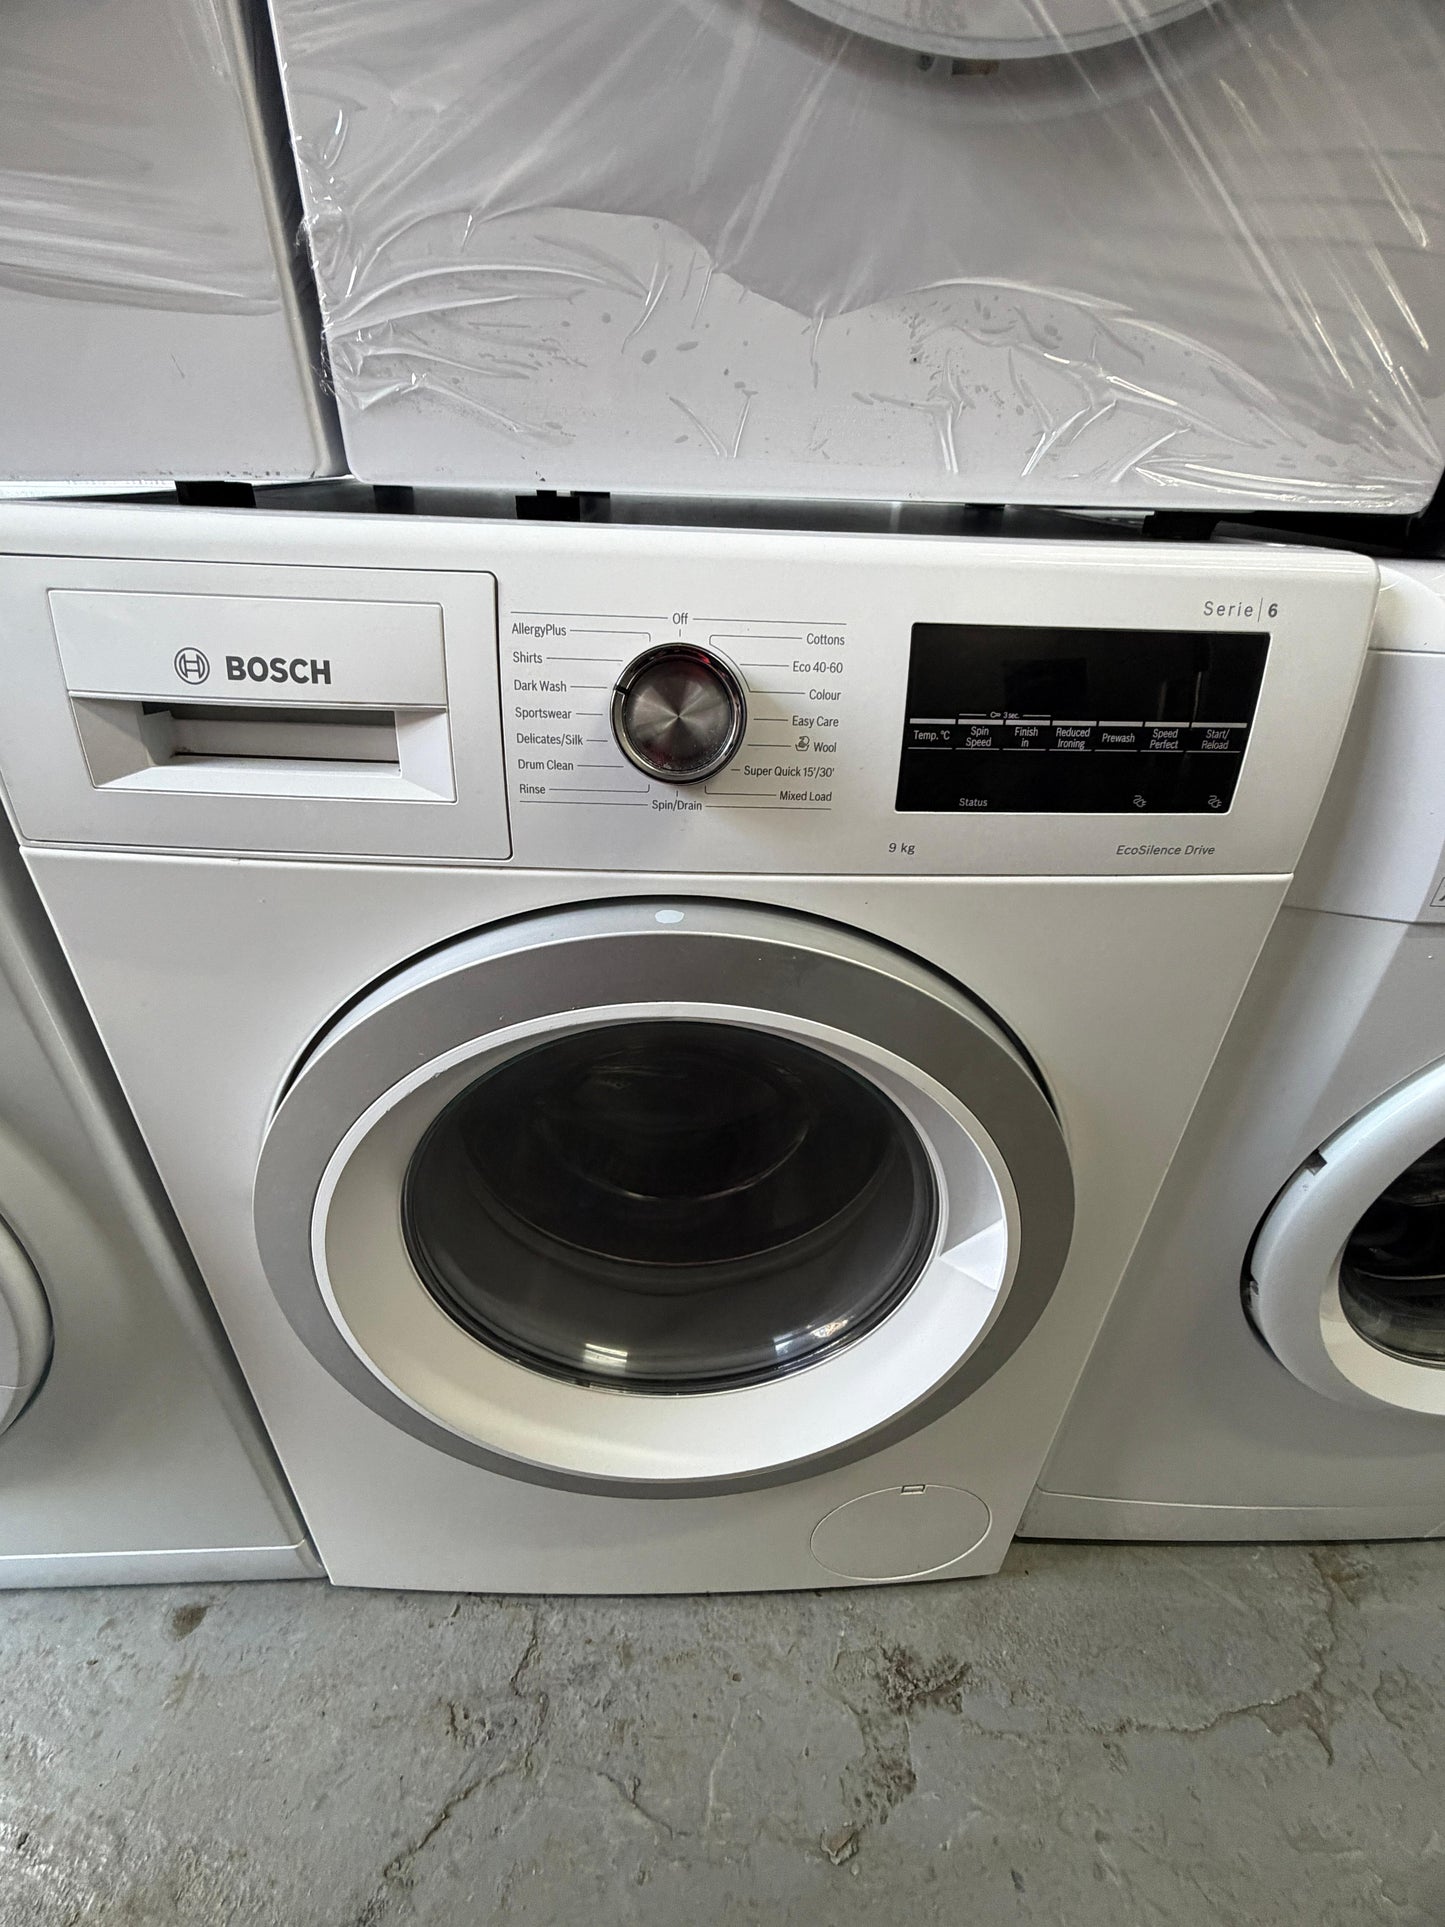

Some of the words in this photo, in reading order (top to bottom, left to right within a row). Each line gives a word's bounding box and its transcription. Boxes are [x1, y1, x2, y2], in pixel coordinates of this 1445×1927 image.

[1203, 600, 1254, 617] Serie
[672, 613, 689, 625] Off
[511, 622, 567, 638] AllergyPlus
[806, 633, 846, 646] Cottons
[512, 651, 543, 664] Shirts
[225, 655, 332, 685] BOSCH
[792, 660, 811, 673] Eco
[813, 661, 844, 674] 40-60
[513, 679, 538, 692] Dark
[539, 680, 567, 693] Wash
[809, 688, 842, 701] Colour
[515, 706, 572, 720] Sportswear
[1003, 711, 1009, 719] 3
[792, 715, 815, 729] Easy
[816, 715, 839, 728] Care
[913, 729, 939, 742] Temp.
[940, 730, 951, 741] °C
[970, 726, 990, 737] Spin
[1014, 726, 1039, 738] Finish
[1055, 726, 1091, 738] Reduced
[1152, 728, 1179, 740] Speed
[1205, 728, 1230, 740] Start/
[516, 733, 584, 746] Delicates/Silk
[965, 737, 992, 749] Speed
[1021, 737, 1030, 748] in
[1057, 738, 1086, 750] Ironing
[1101, 732, 1136, 744] Prewash
[813, 742, 837, 753] Wool
[1149, 739, 1179, 750] Perfect
[1201, 740, 1229, 750] Reload
[517, 759, 545, 771] Drum
[546, 760, 574, 771] Clean
[743, 765, 772, 778] Super
[774, 766, 801, 777] Quick
[803, 767, 835, 779] 15'/30'
[519, 784, 546, 795] Rinse
[779, 791, 807, 801] Mixed
[809, 792, 832, 802] Load
[959, 798, 988, 807] Status
[651, 800, 702, 811] Spin/Drain
[888, 842, 897, 853] 9
[900, 842, 915, 855] kg
[1116, 845, 1181, 856] EcoSilence
[1184, 845, 1215, 856] Drive
